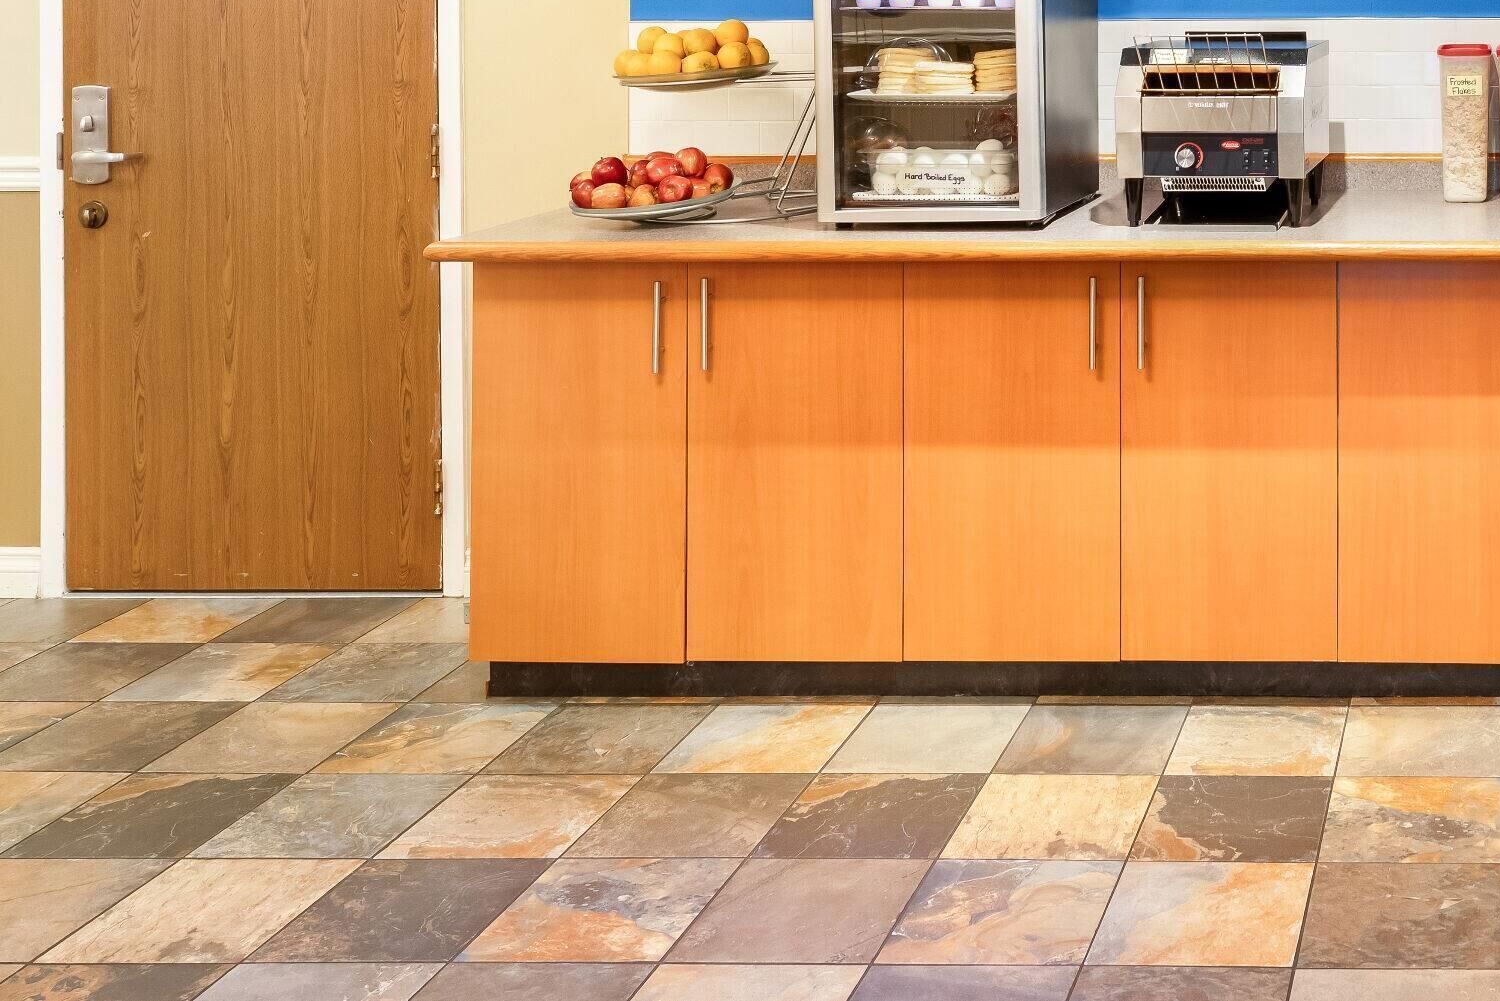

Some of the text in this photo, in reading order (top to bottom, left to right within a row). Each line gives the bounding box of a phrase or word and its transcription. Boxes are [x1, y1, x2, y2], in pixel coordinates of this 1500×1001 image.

[1449, 77, 1477, 86] Frosted
[1452, 87, 1477, 95] Flakes
[904, 172, 966, 185] Hard Boiled Eggs
